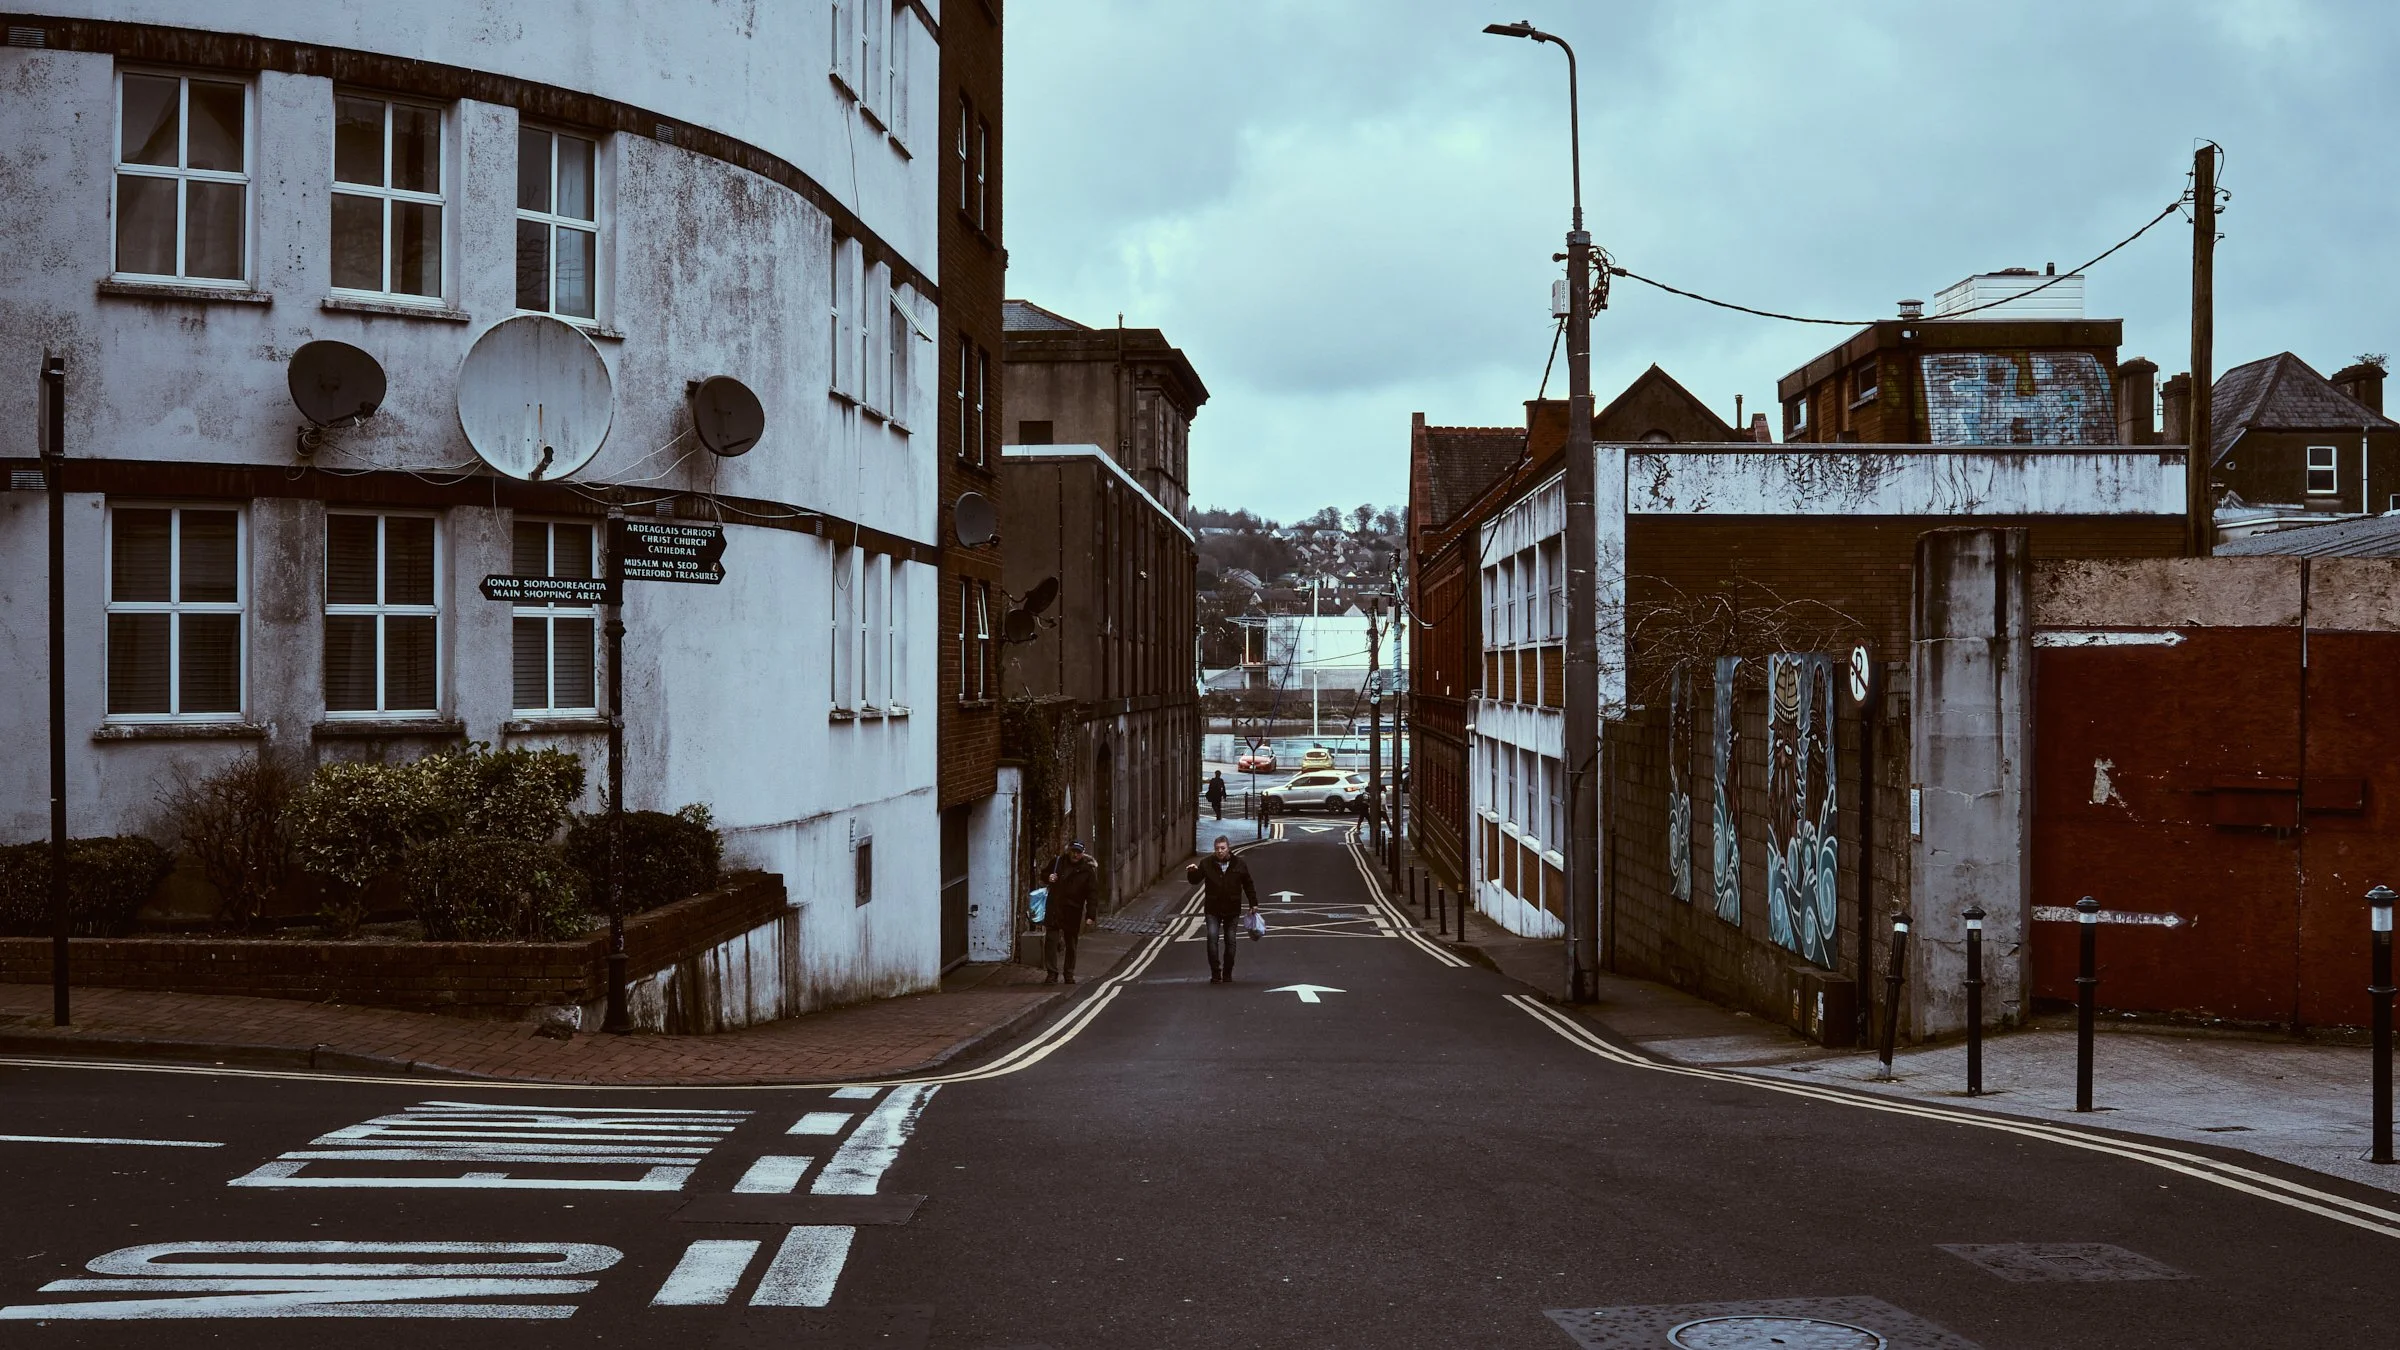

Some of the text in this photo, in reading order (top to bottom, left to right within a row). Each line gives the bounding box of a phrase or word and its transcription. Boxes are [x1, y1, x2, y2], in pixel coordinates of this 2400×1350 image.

[627, 523, 679, 535] ARDEAGLAIS
[641, 535, 707, 547] CHRIST CHURCH
[648, 545, 697, 556] CATHEDRAL
[624, 558, 699, 570] MUSAEM NA SEOD
[624, 568, 719, 581] WATERFORD TREASURES
[487, 578, 520, 588] IONAD
[493, 589, 602, 600] MAIN SHOPPING AREA
[0, 1101, 757, 1320] NO ENTRY
